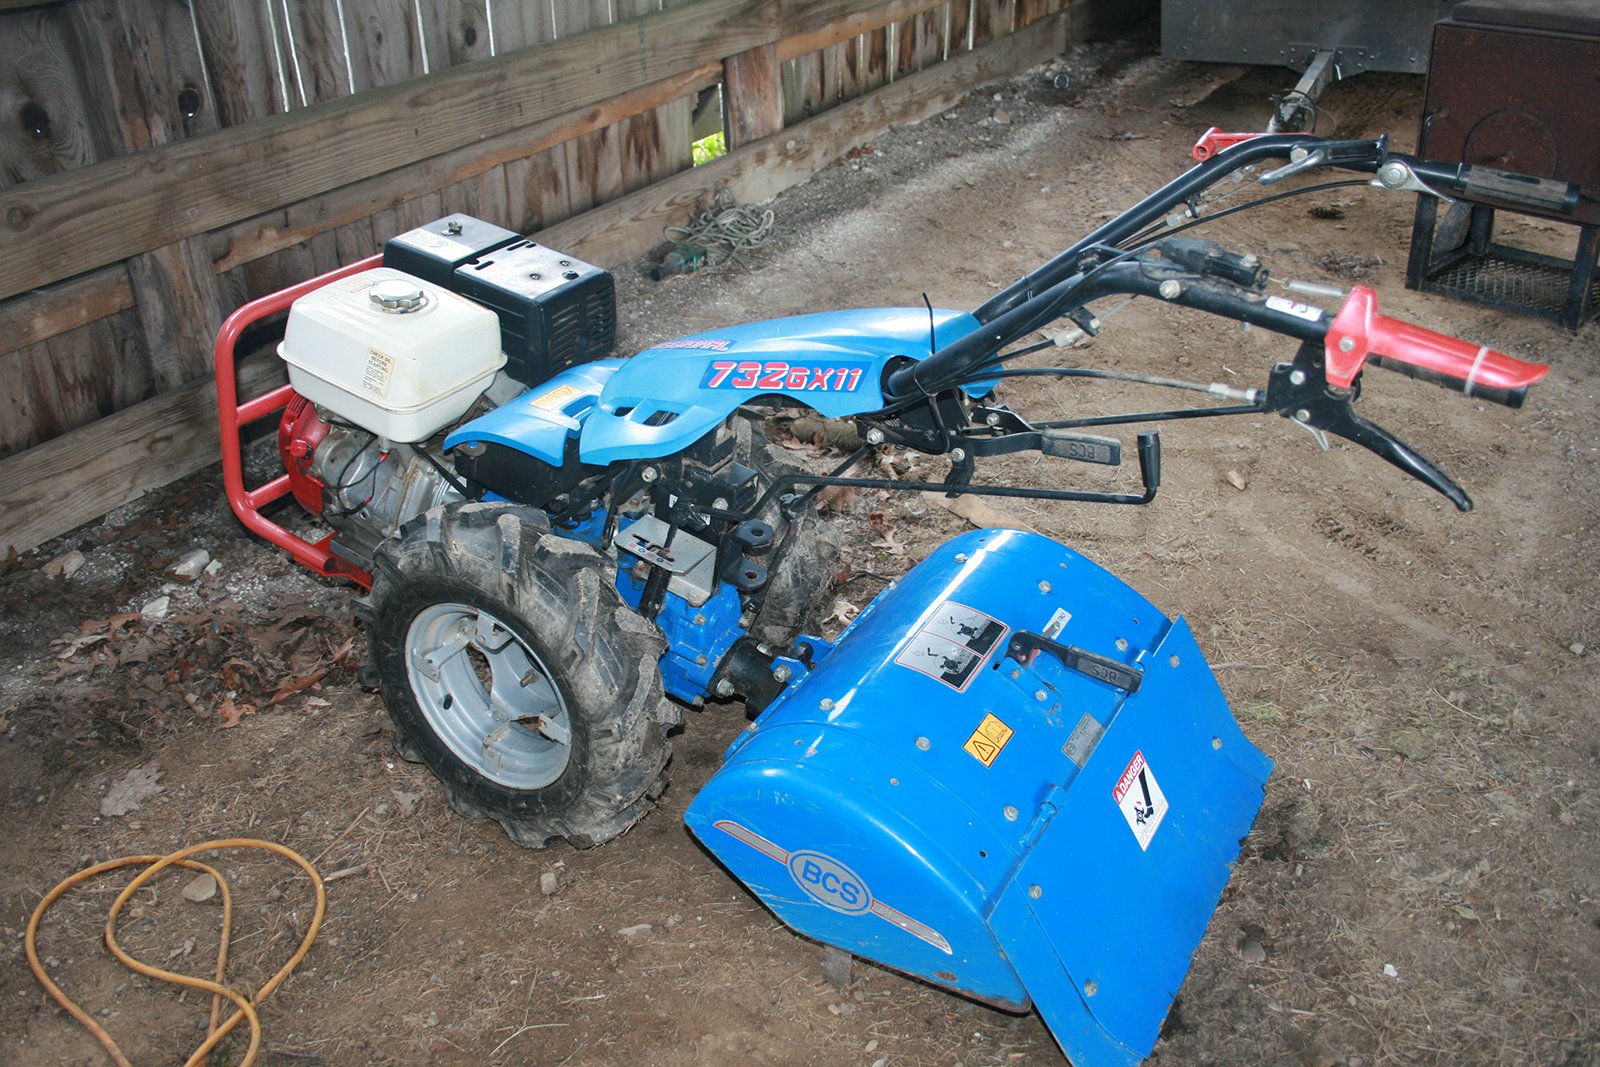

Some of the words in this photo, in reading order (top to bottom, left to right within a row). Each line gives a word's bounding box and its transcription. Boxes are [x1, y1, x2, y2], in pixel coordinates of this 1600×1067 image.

[1069, 442, 1096, 460] BCS
[1091, 664, 1118, 683] BCS
[1119, 754, 1144, 794] DANGER
[801, 859, 861, 905] BCS
